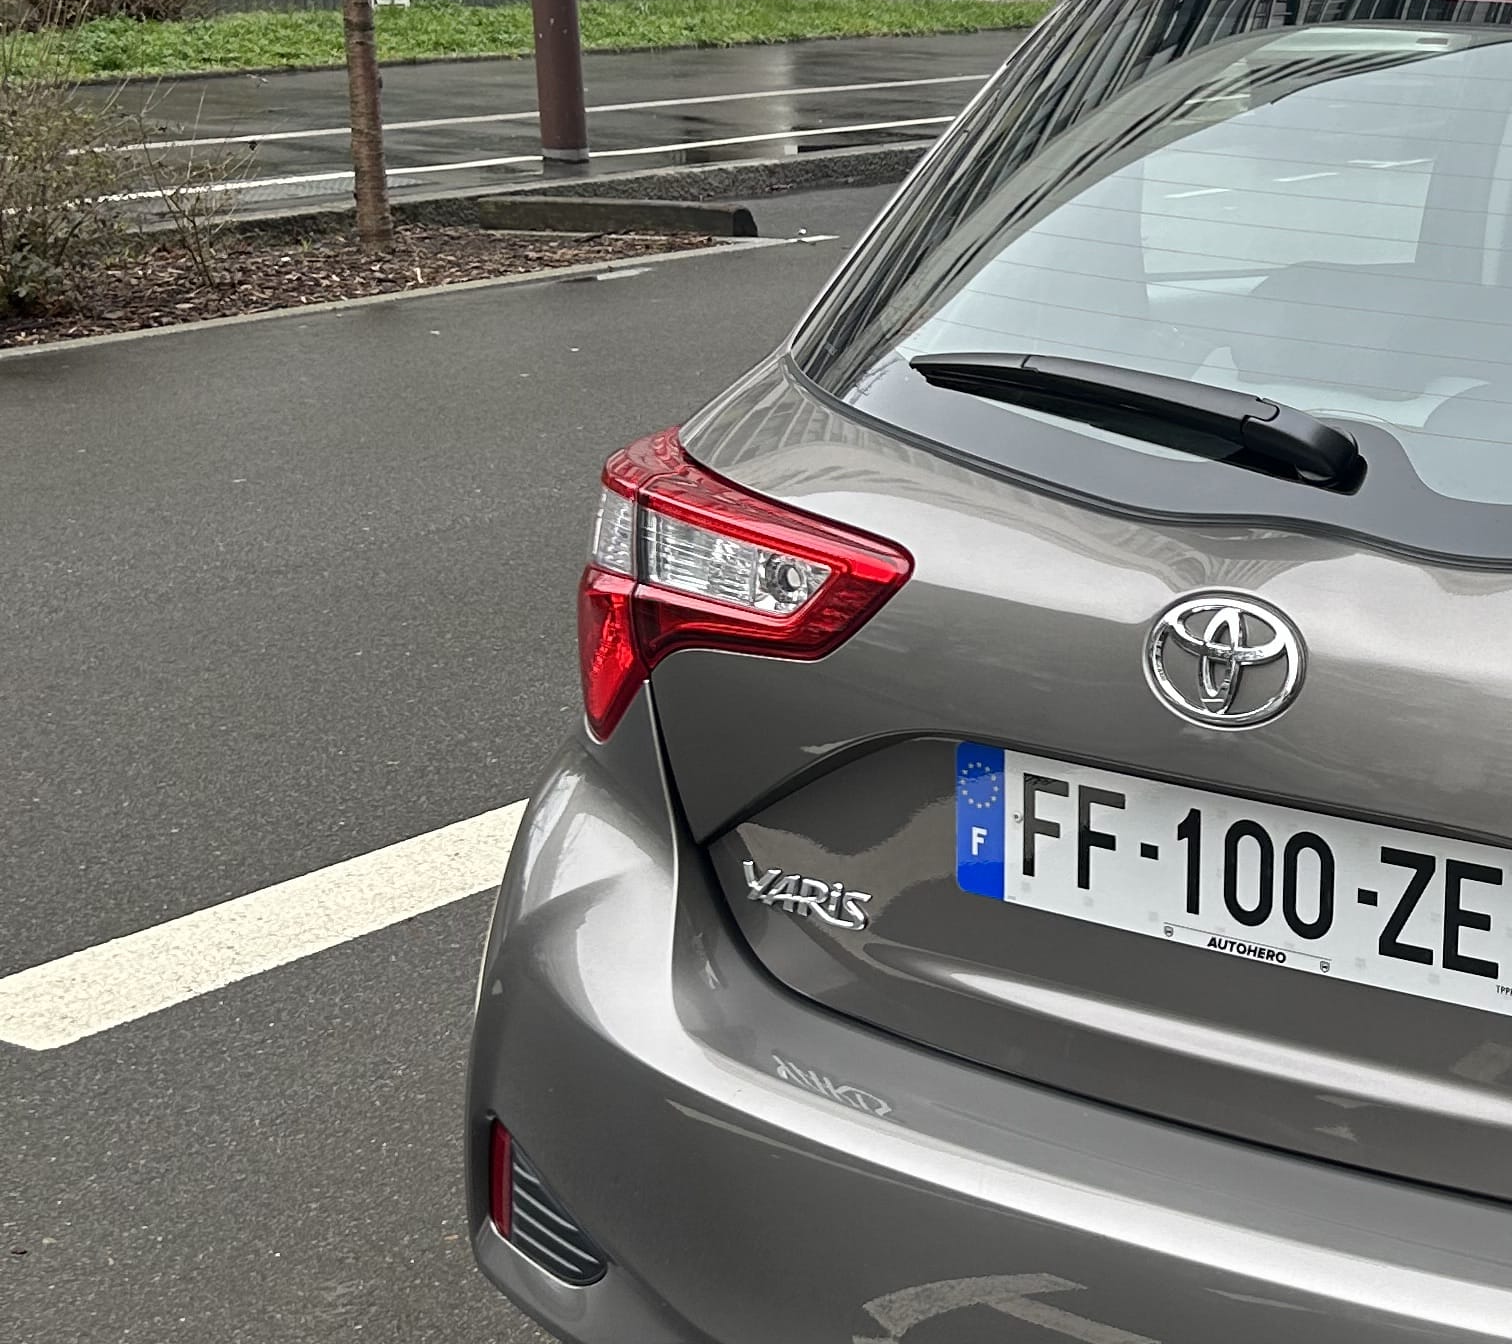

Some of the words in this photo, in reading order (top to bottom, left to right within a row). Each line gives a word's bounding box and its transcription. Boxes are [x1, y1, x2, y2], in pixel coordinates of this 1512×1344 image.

[972, 827, 988, 856] F
[1022, 772, 1503, 980] FF-100-ZE
[1207, 936, 1287, 964] AUTOHERO
